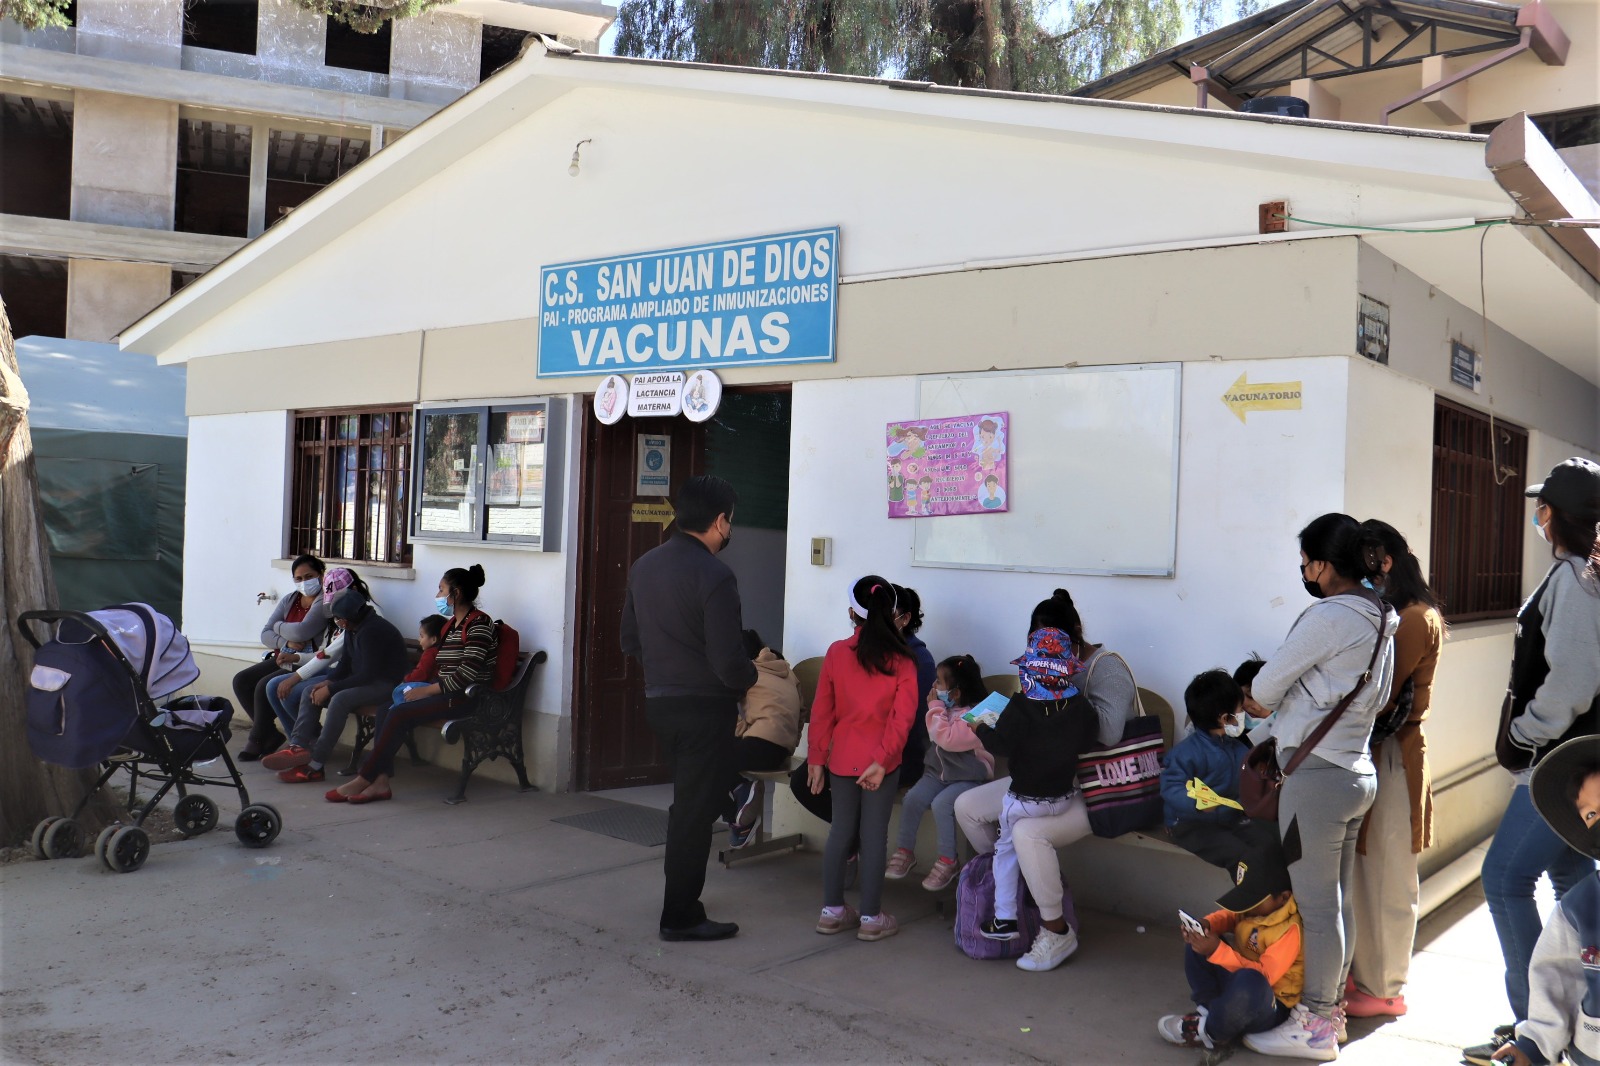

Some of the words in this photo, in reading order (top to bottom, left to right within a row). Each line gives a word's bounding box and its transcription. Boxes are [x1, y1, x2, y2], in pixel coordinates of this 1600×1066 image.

[545, 268, 583, 307] C.S.
[596, 261, 642, 301] SAN
[648, 252, 714, 296] JUAN
[722, 246, 756, 288] DE
[764, 237, 830, 283] DIOS
[543, 311, 559, 328] PAI
[567, 304, 628, 325] PROGRAMA
[630, 296, 690, 320] AMPLIADO
[693, 295, 709, 314] DE
[712, 283, 829, 312] INMUNIZACIONES
[571, 311, 791, 367] VACUNAS
[647, 375, 670, 384] APOYA
[636, 389, 676, 398] LACTANCIA
[1223, 391, 1301, 402] VACUNATORIO
[637, 403, 671, 411] MATERNA
[1095, 757, 1140, 787] LOVE
